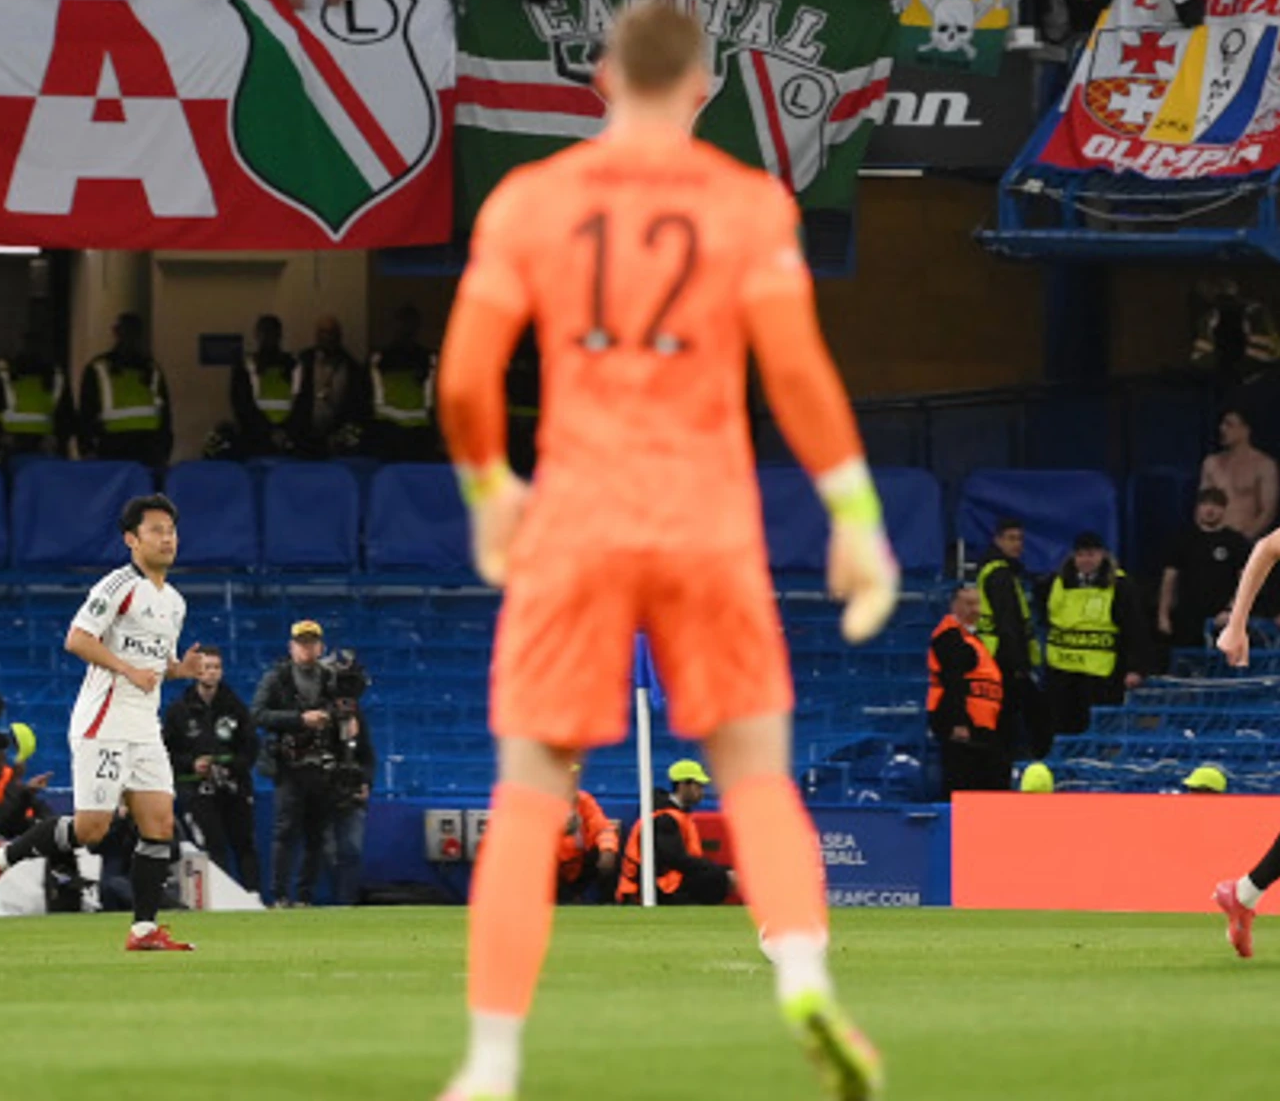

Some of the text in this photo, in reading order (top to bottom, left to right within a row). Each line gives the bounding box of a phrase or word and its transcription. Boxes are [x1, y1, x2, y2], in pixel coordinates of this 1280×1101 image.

[346, 0, 379, 34] L
[790, 83, 811, 110] L
[569, 211, 698, 352] 12
[96, 748, 122, 781] 25
